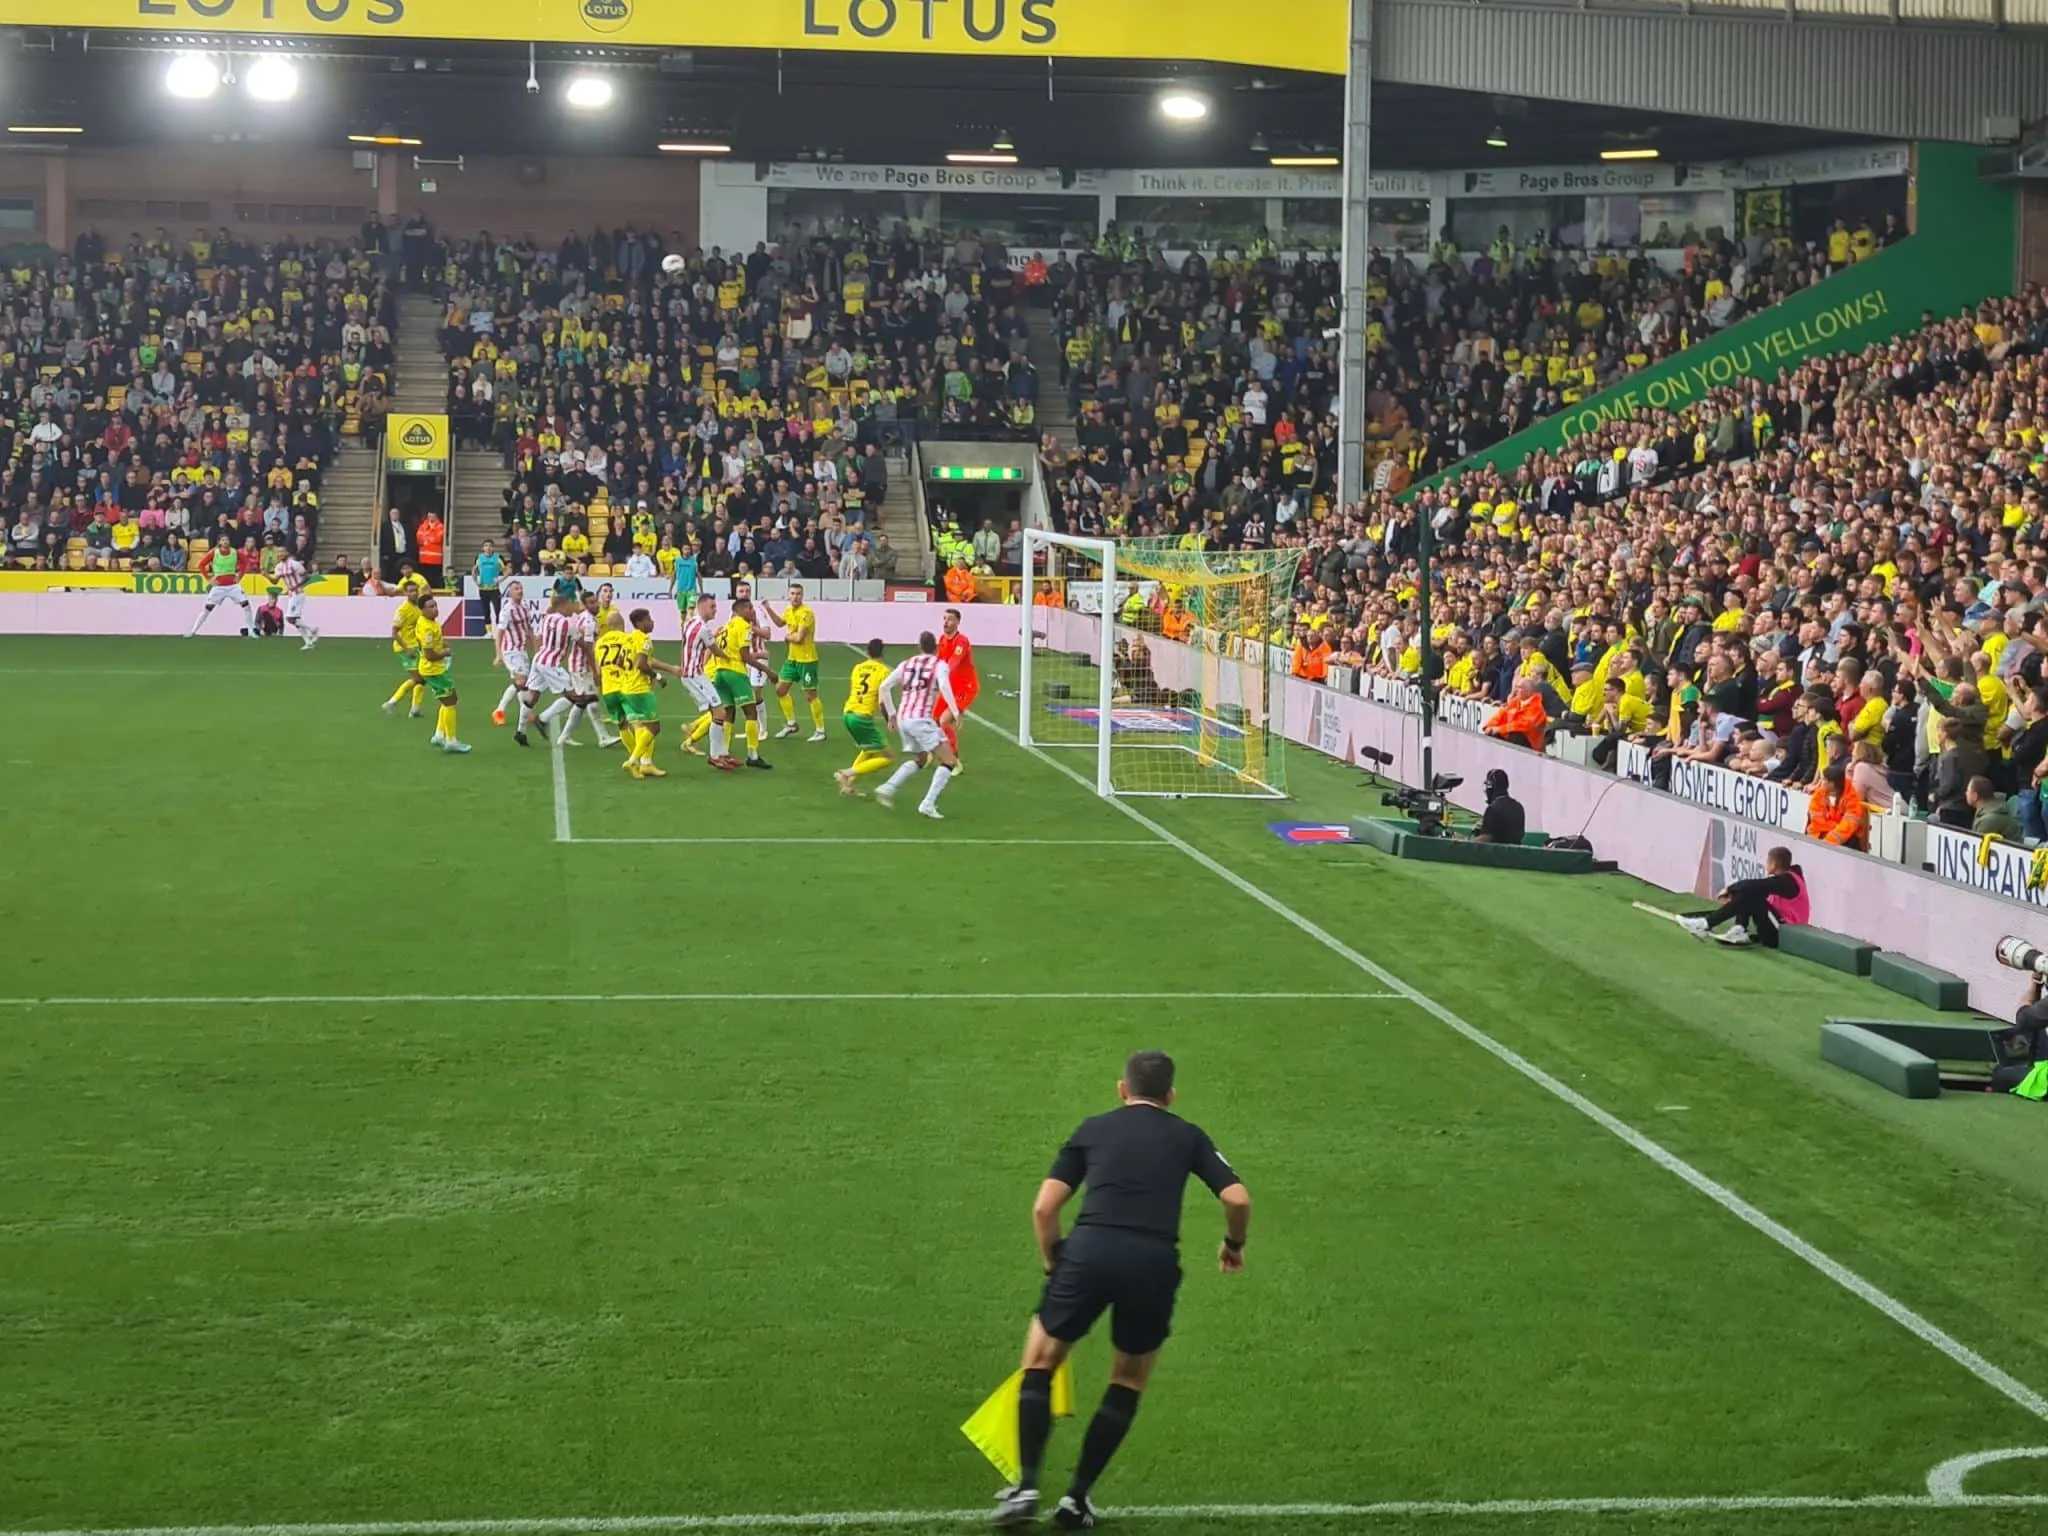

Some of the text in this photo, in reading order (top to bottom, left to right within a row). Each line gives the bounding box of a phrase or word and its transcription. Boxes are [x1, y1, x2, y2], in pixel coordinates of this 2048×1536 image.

[587, 5, 625, 16] LOTUS
[804, 0, 1056, 44] LOTUS
[815, 166, 1037, 189] We are Page Bros Group
[1139, 175, 1186, 191] Think
[1214, 175, 1272, 191] Create
[1520, 171, 1655, 191] Page Bros Group
[1647, 372, 1691, 408] ON
[1692, 345, 1752, 387] YOU
[1753, 290, 1888, 364] YELLOWS!
[405, 436, 430, 444] LOTUS
[805, 671, 812, 685] 6
[857, 673, 870, 695] 3
[1626, 748, 1789, 827] ALA OSWELL GROUP
[1732, 824, 1757, 855] ALAN
[1937, 834, 2047, 907] INSURAN
